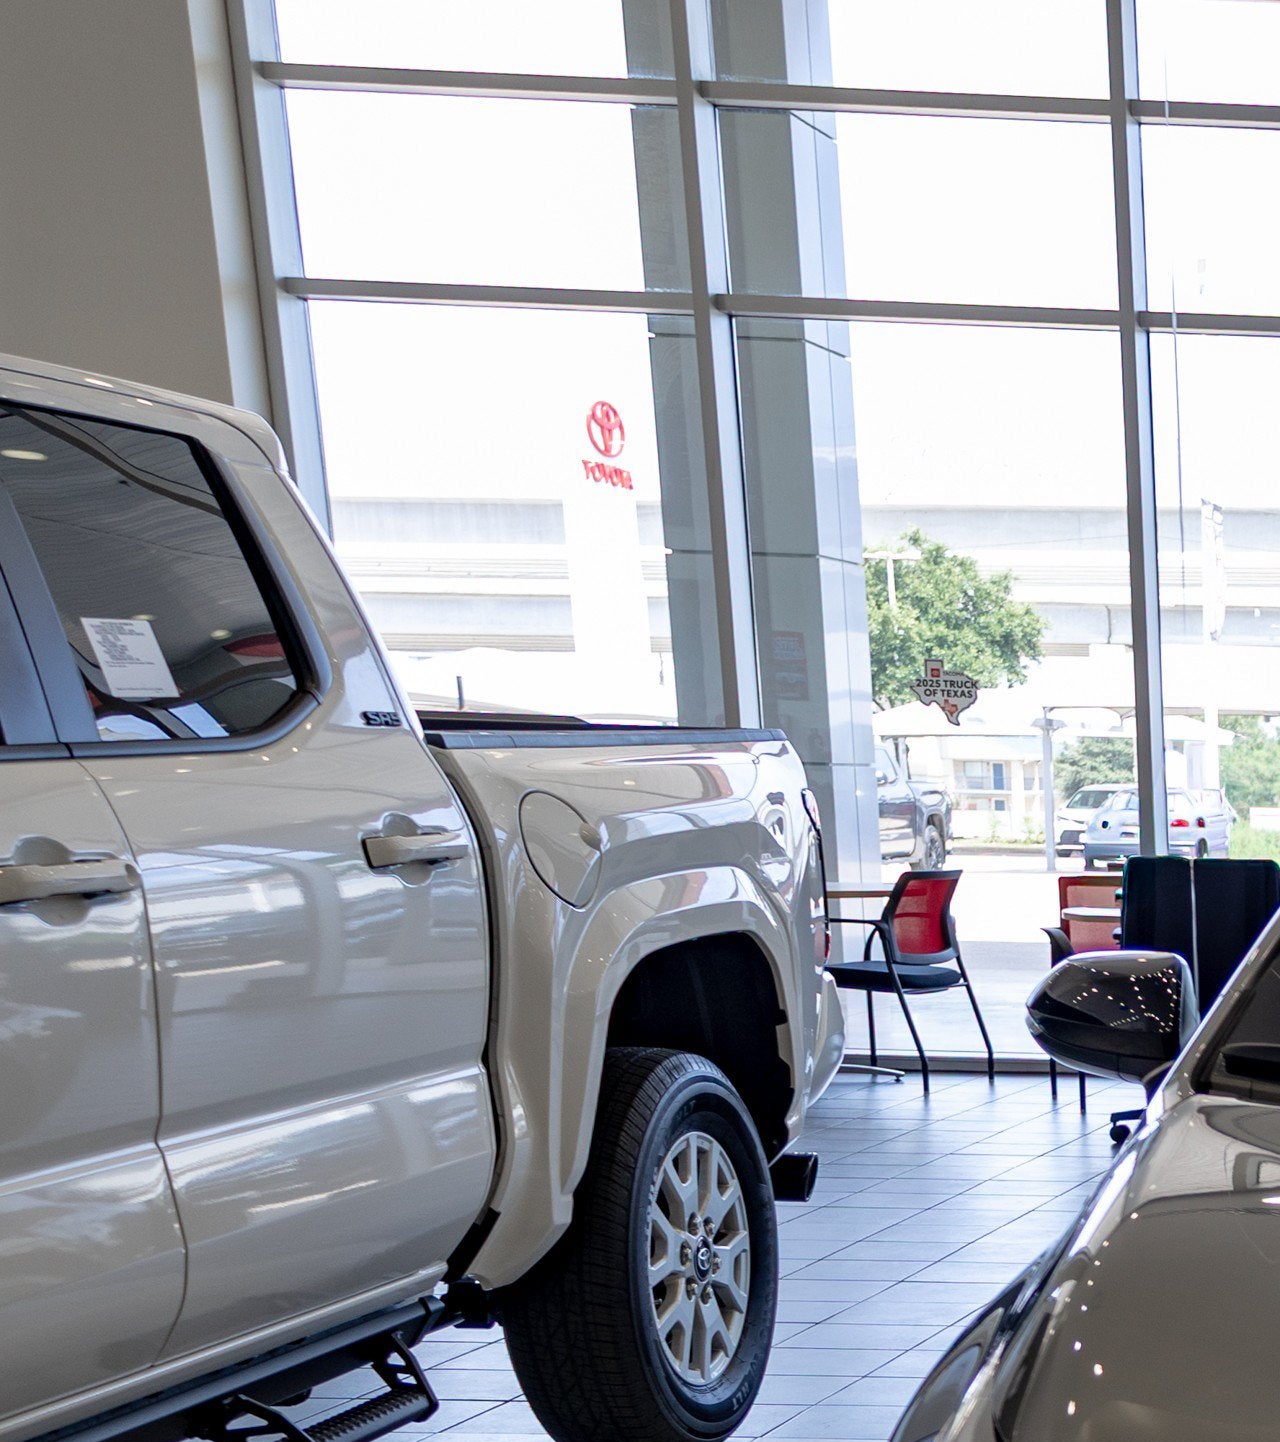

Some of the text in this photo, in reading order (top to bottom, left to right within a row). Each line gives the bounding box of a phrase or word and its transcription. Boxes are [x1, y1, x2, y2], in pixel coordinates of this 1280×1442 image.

[582, 459, 633, 490] TOYOTA
[916, 679, 978, 689] 2025 TRUCK
[924, 689, 973, 698] OF TEXAS
